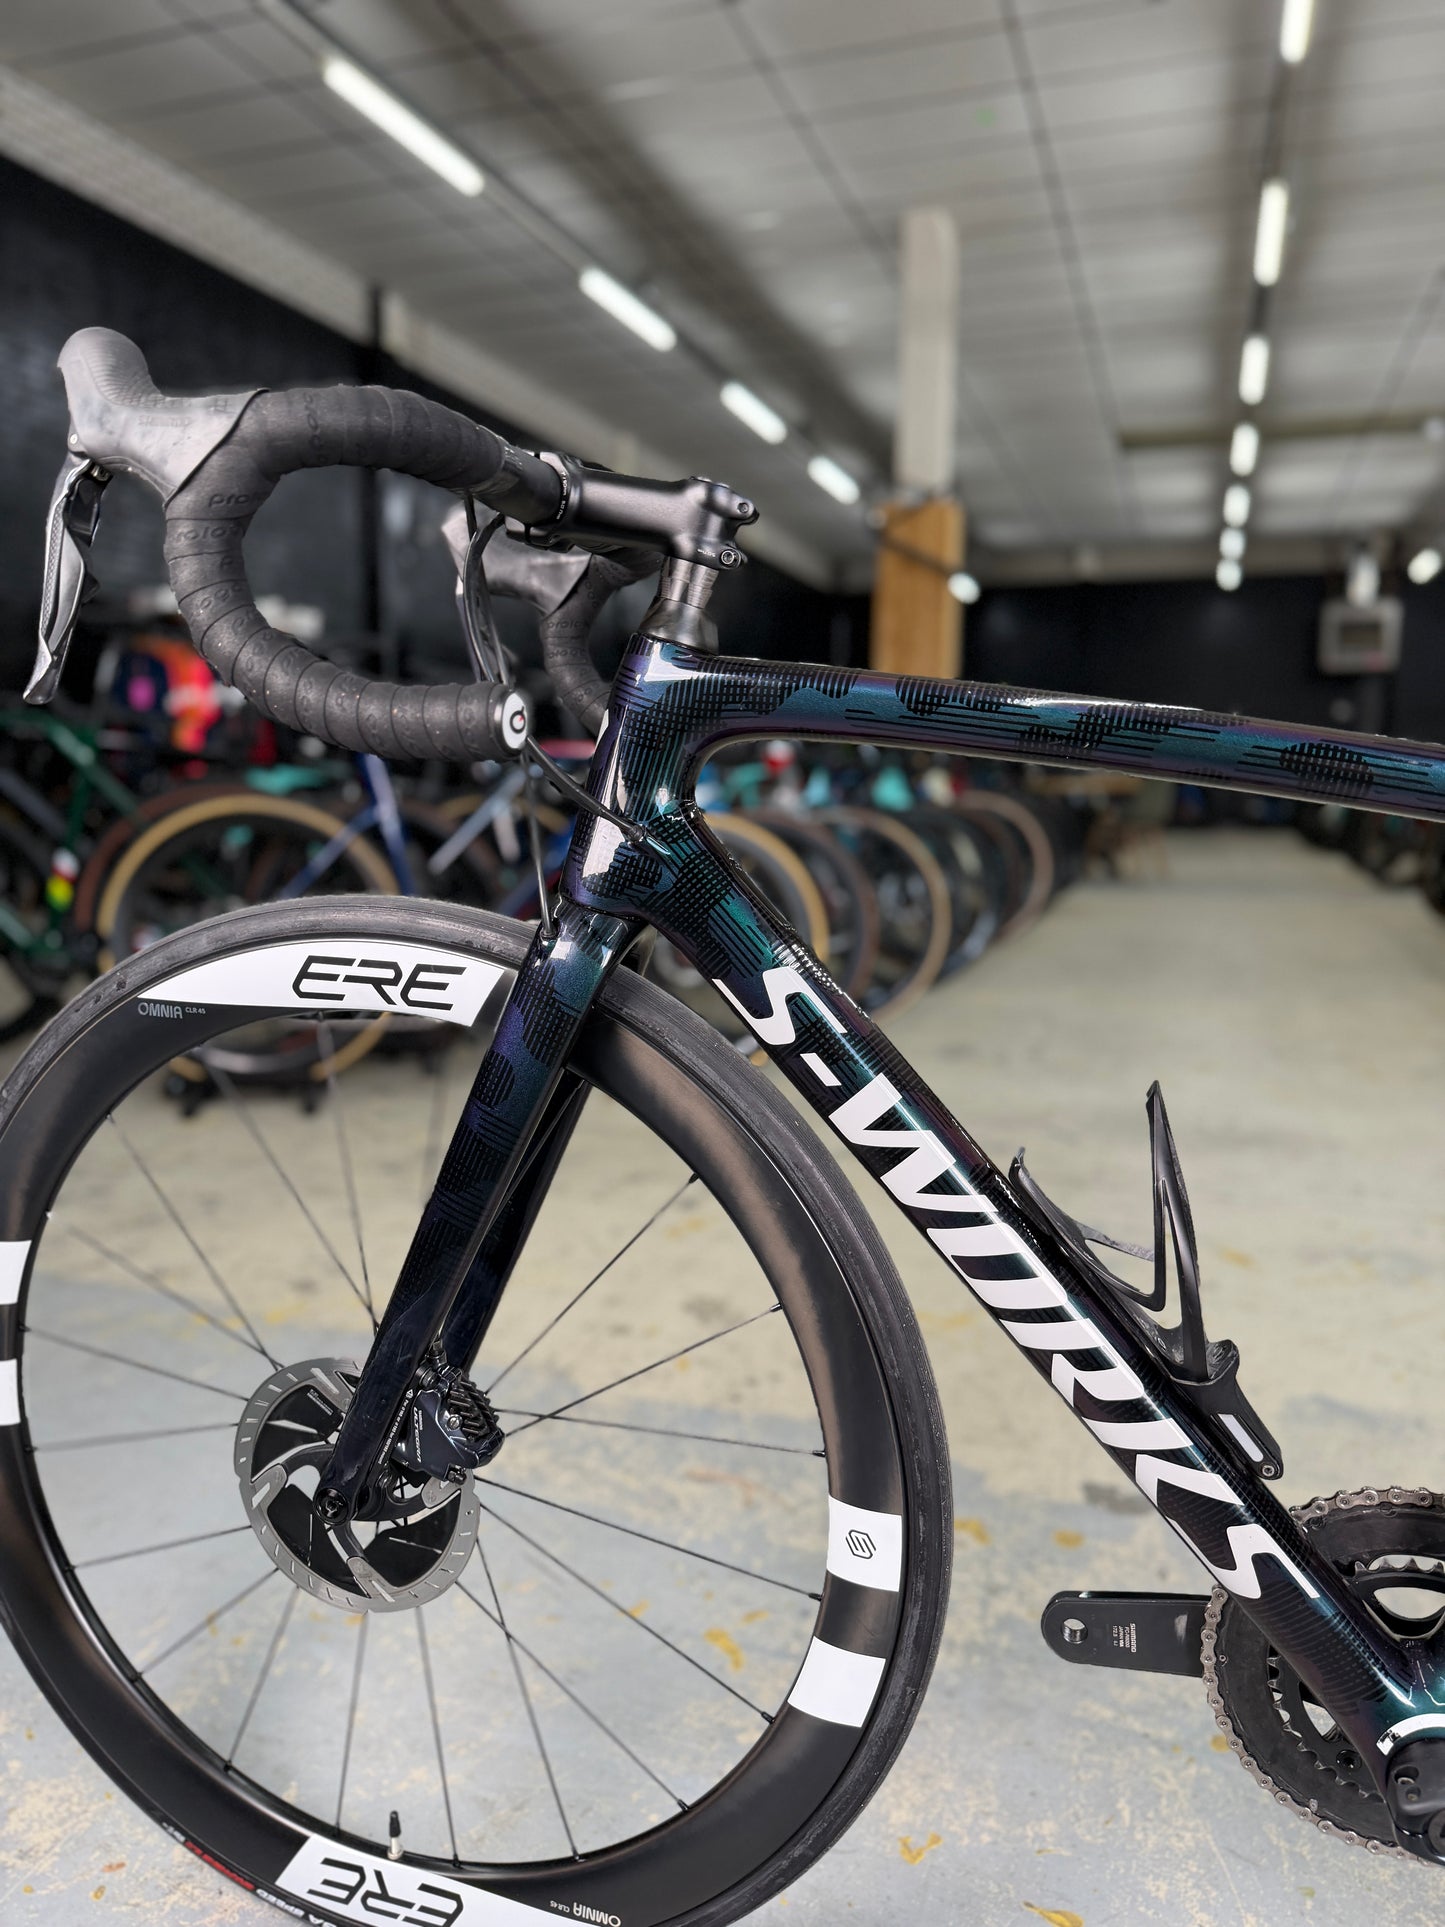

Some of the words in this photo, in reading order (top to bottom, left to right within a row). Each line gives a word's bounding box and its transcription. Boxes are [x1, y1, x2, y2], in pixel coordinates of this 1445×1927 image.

[292, 955, 467, 1011] ERE
[138, 1002, 183, 1019] OMNIA
[185, 1006, 198, 1014] CLR
[198, 1007, 206, 1015] 45
[711, 965, 1320, 1599] S-WORKS
[413, 1406, 422, 1463] ULTEGRA
[256, 1888, 305, 1917] SPEED
[307, 1857, 465, 1927] ERE
[558, 1903, 570, 1913] CLR
[573, 1902, 621, 1927] OMNIA
